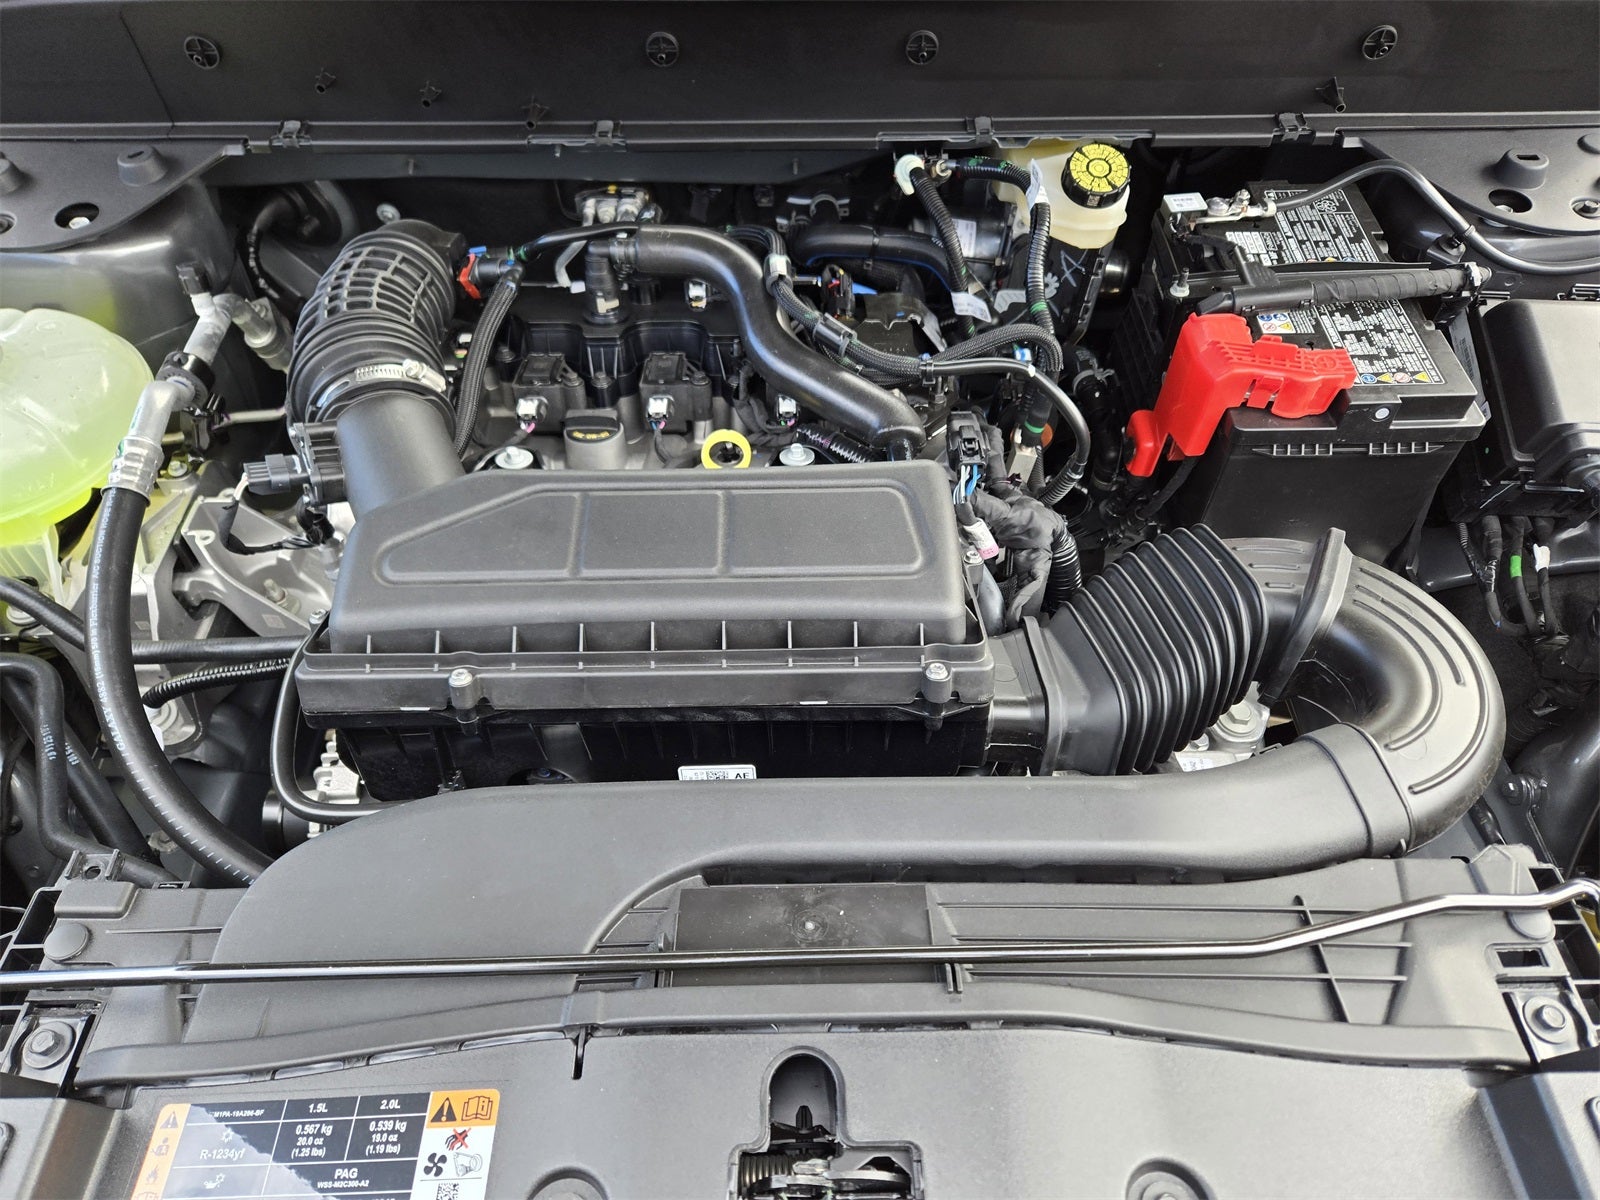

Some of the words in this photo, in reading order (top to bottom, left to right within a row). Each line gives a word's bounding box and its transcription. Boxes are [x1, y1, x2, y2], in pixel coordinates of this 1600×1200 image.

[101, 507, 112, 527] HOSE
[94, 530, 106, 564] SUCTION
[96, 681, 108, 703] 4882
[102, 707, 126, 751] GALAXY
[308, 1103, 329, 1113] 1.5L
[379, 1099, 401, 1110] 2.0L
[295, 1124, 320, 1135] 0.567
[320, 1123, 333, 1136] kg
[369, 1120, 394, 1132] 0.539
[394, 1120, 407, 1133] kg
[296, 1136, 313, 1146] 20.0
[313, 1137, 324, 1145] oz
[371, 1134, 387, 1143] 19.0
[387, 1133, 398, 1142] oz
[199, 1147, 246, 1161] R-1234yf
[290, 1147, 310, 1159] (1.25
[310, 1147, 327, 1158] lbs)
[365, 1144, 385, 1156] (1.19
[385, 1143, 401, 1155] lbs)
[334, 1167, 359, 1179] PAG
